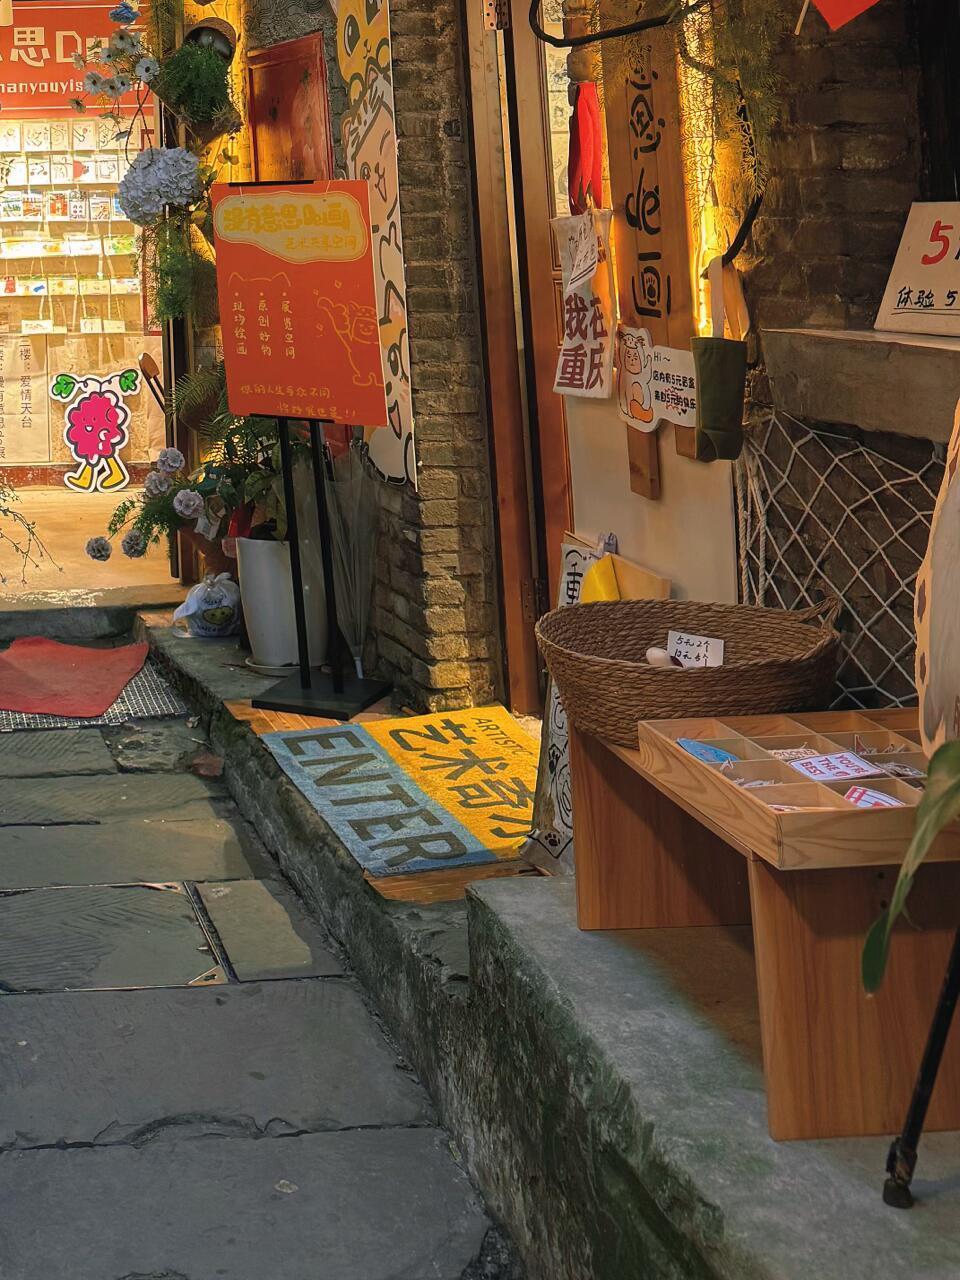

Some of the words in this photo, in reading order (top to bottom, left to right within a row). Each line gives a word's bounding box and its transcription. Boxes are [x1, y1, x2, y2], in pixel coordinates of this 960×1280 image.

[565, 292, 608, 342] 我在
[897, 286, 935, 308] 体验
[556, 343, 605, 390] 重庆
[800, 762, 827, 776] BEST
[281, 729, 468, 868] ENTER
